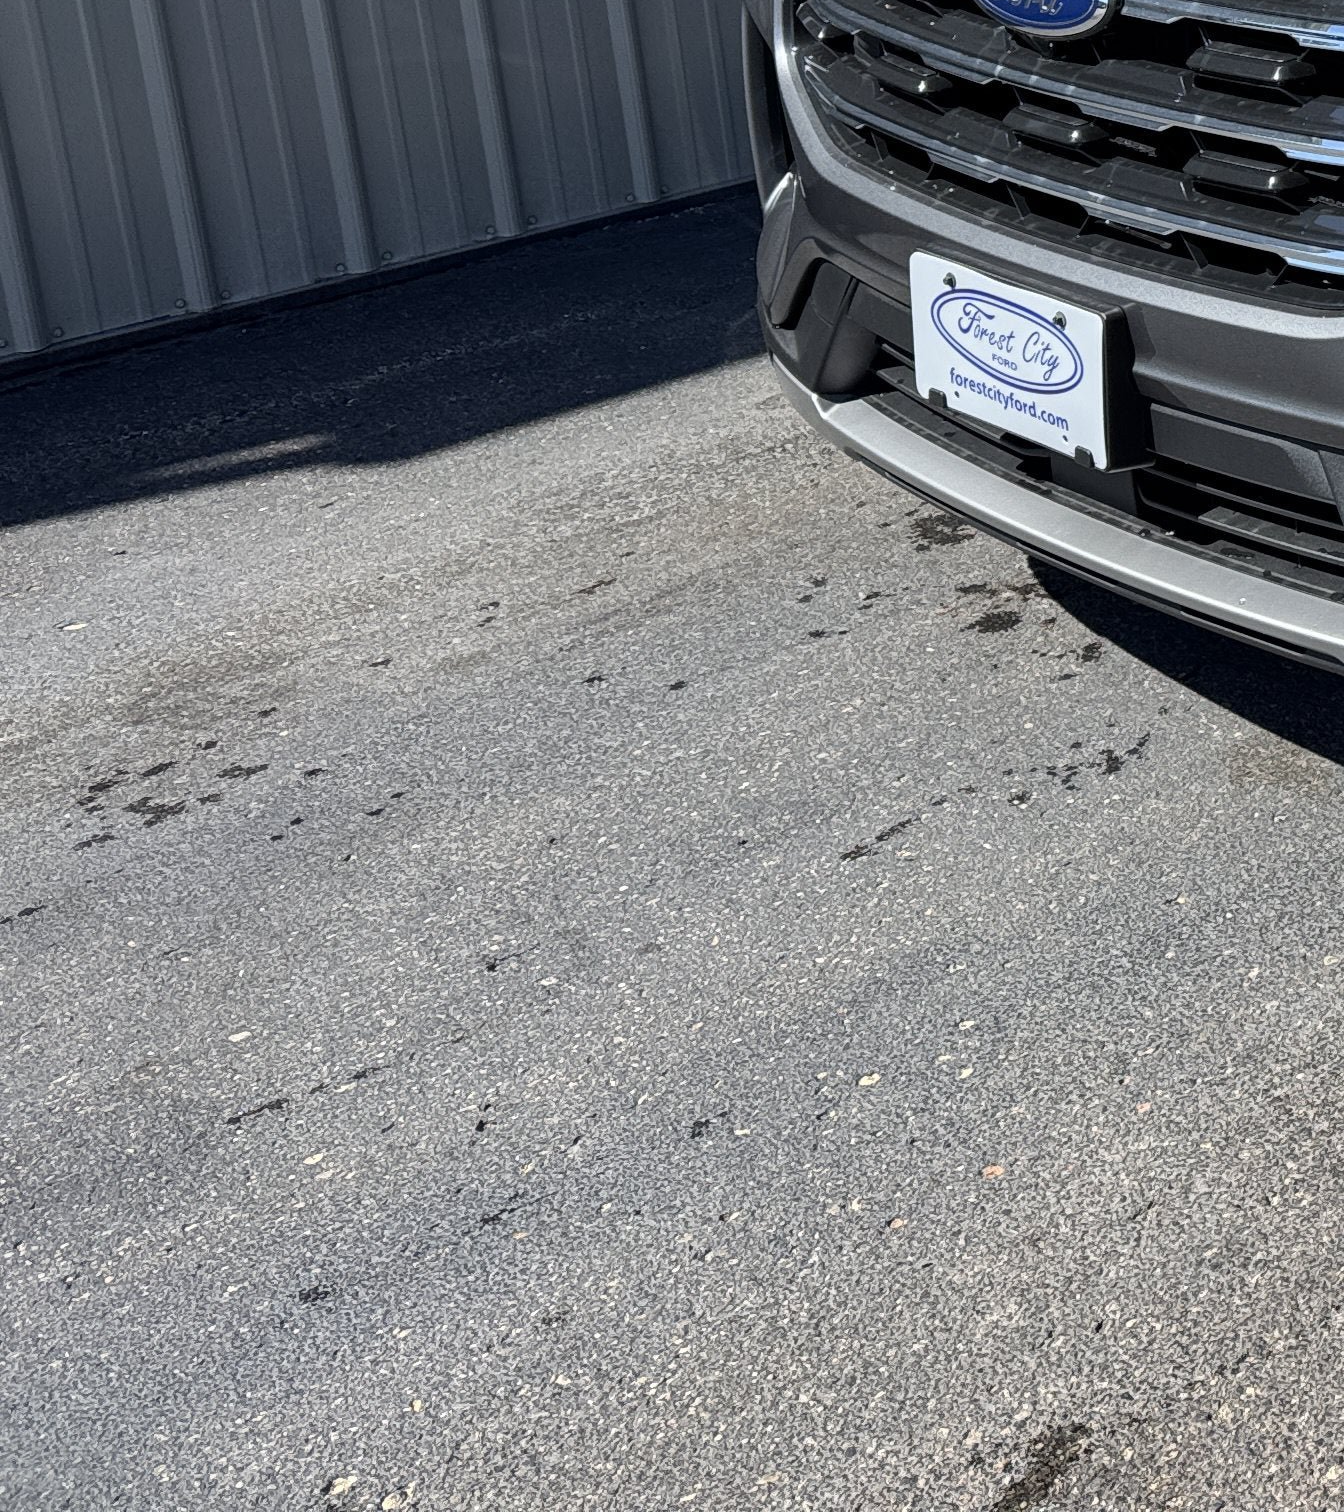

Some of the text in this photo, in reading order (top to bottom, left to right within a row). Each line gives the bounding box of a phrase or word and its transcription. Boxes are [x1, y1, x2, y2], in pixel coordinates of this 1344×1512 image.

[958, 302, 1060, 381] Forest City
[992, 354, 1018, 371] FORD
[949, 367, 1069, 431] forestcityford.com
